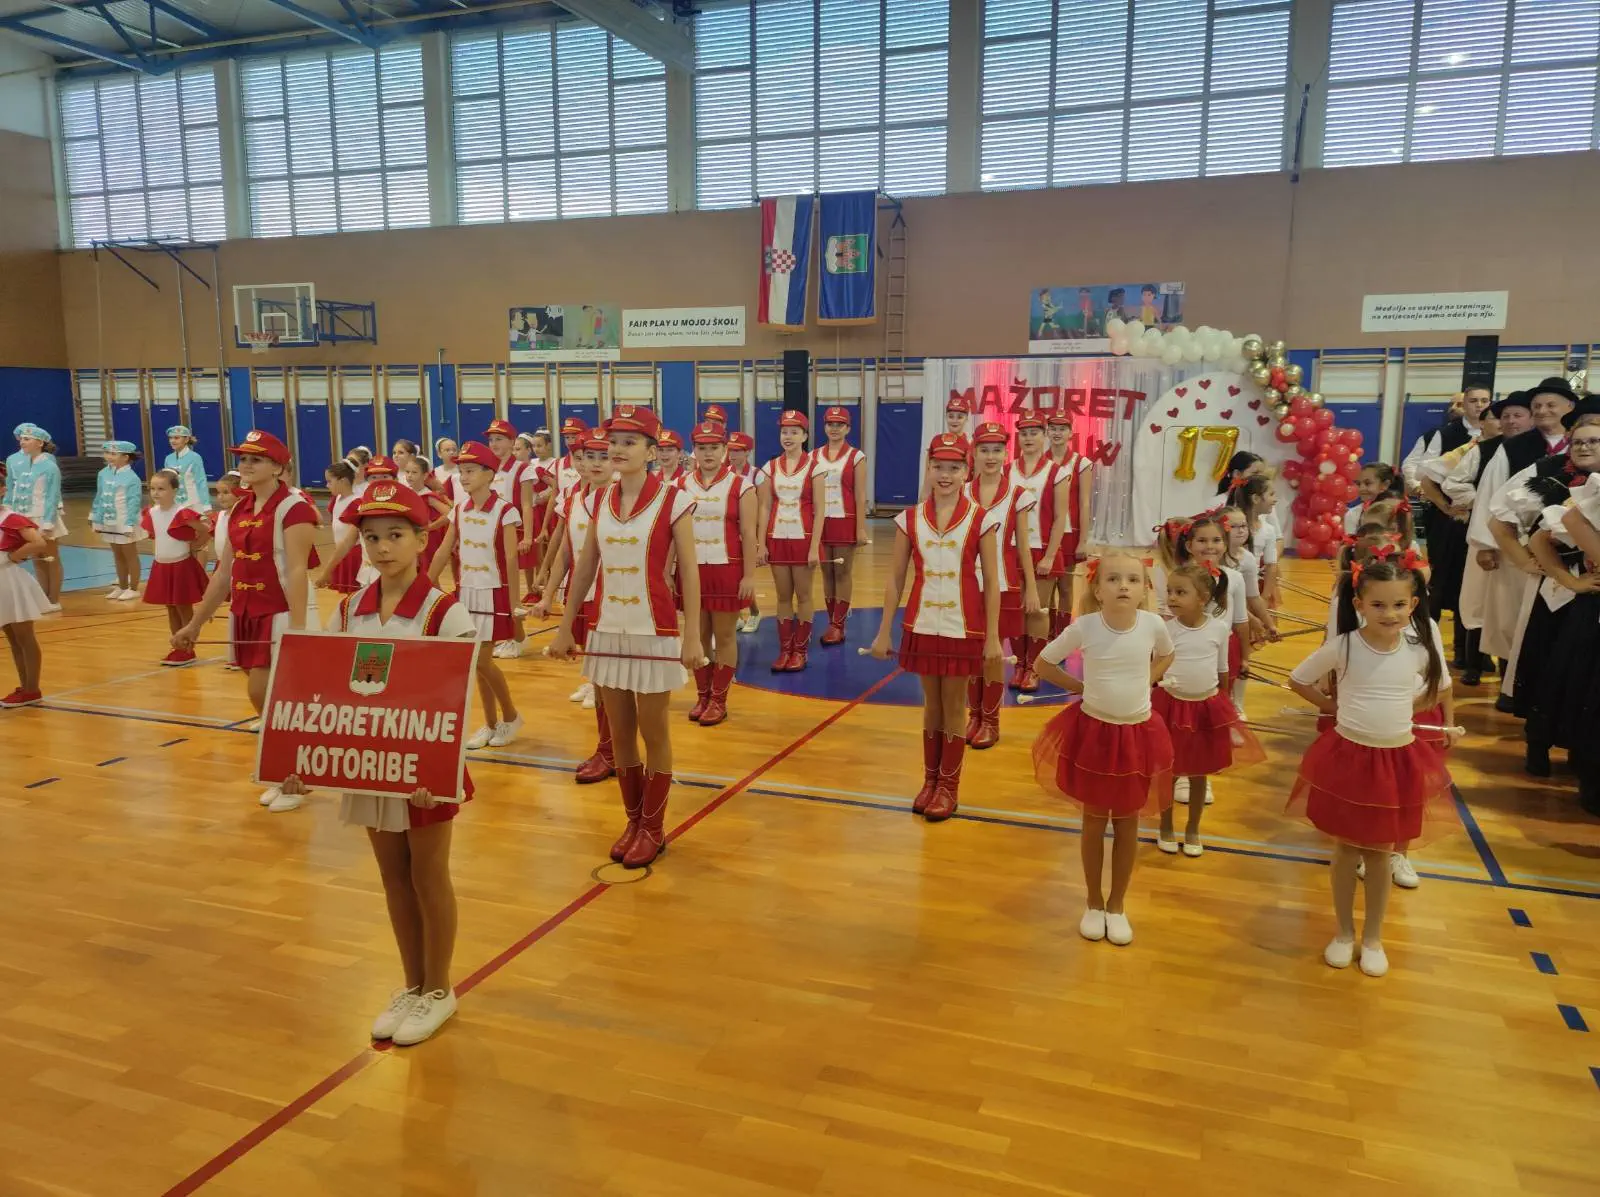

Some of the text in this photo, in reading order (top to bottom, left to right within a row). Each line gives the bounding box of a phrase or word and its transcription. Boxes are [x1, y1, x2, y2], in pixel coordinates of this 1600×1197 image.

[628, 317, 739, 328] FAIR PLAY U MOJOJ ŠKOLI
[950, 377, 1147, 420] MAŽORET
[1173, 426, 1240, 481] 17
[271, 693, 458, 743] MAŽORETKINJE
[296, 744, 419, 784] KOTORIBE
